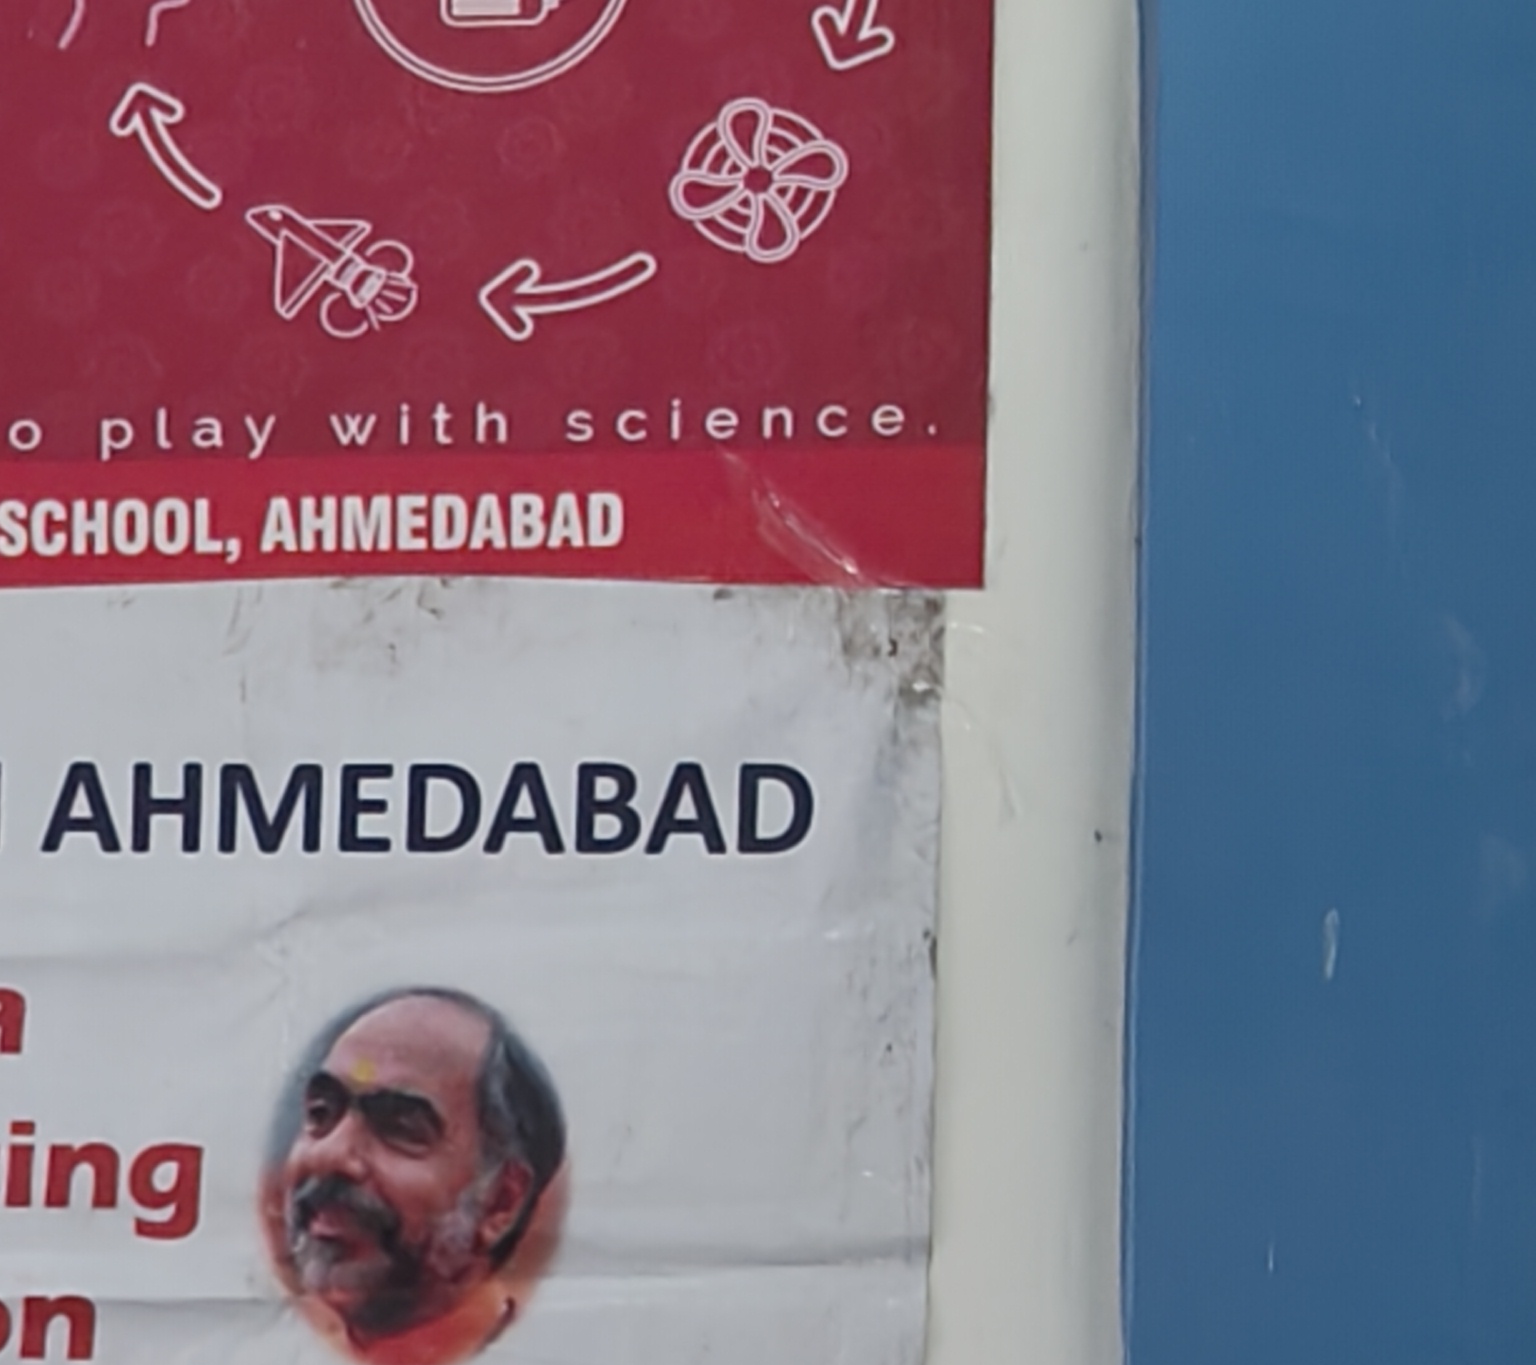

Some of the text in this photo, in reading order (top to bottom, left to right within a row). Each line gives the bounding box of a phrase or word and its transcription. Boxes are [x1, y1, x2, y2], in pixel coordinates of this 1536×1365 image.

[101, 407, 276, 461] play
[330, 402, 507, 445] with
[566, 398, 936, 442] science.
[261, 492, 623, 552] AHMEDABAD
[41, 761, 814, 855] AHMEDABAD
